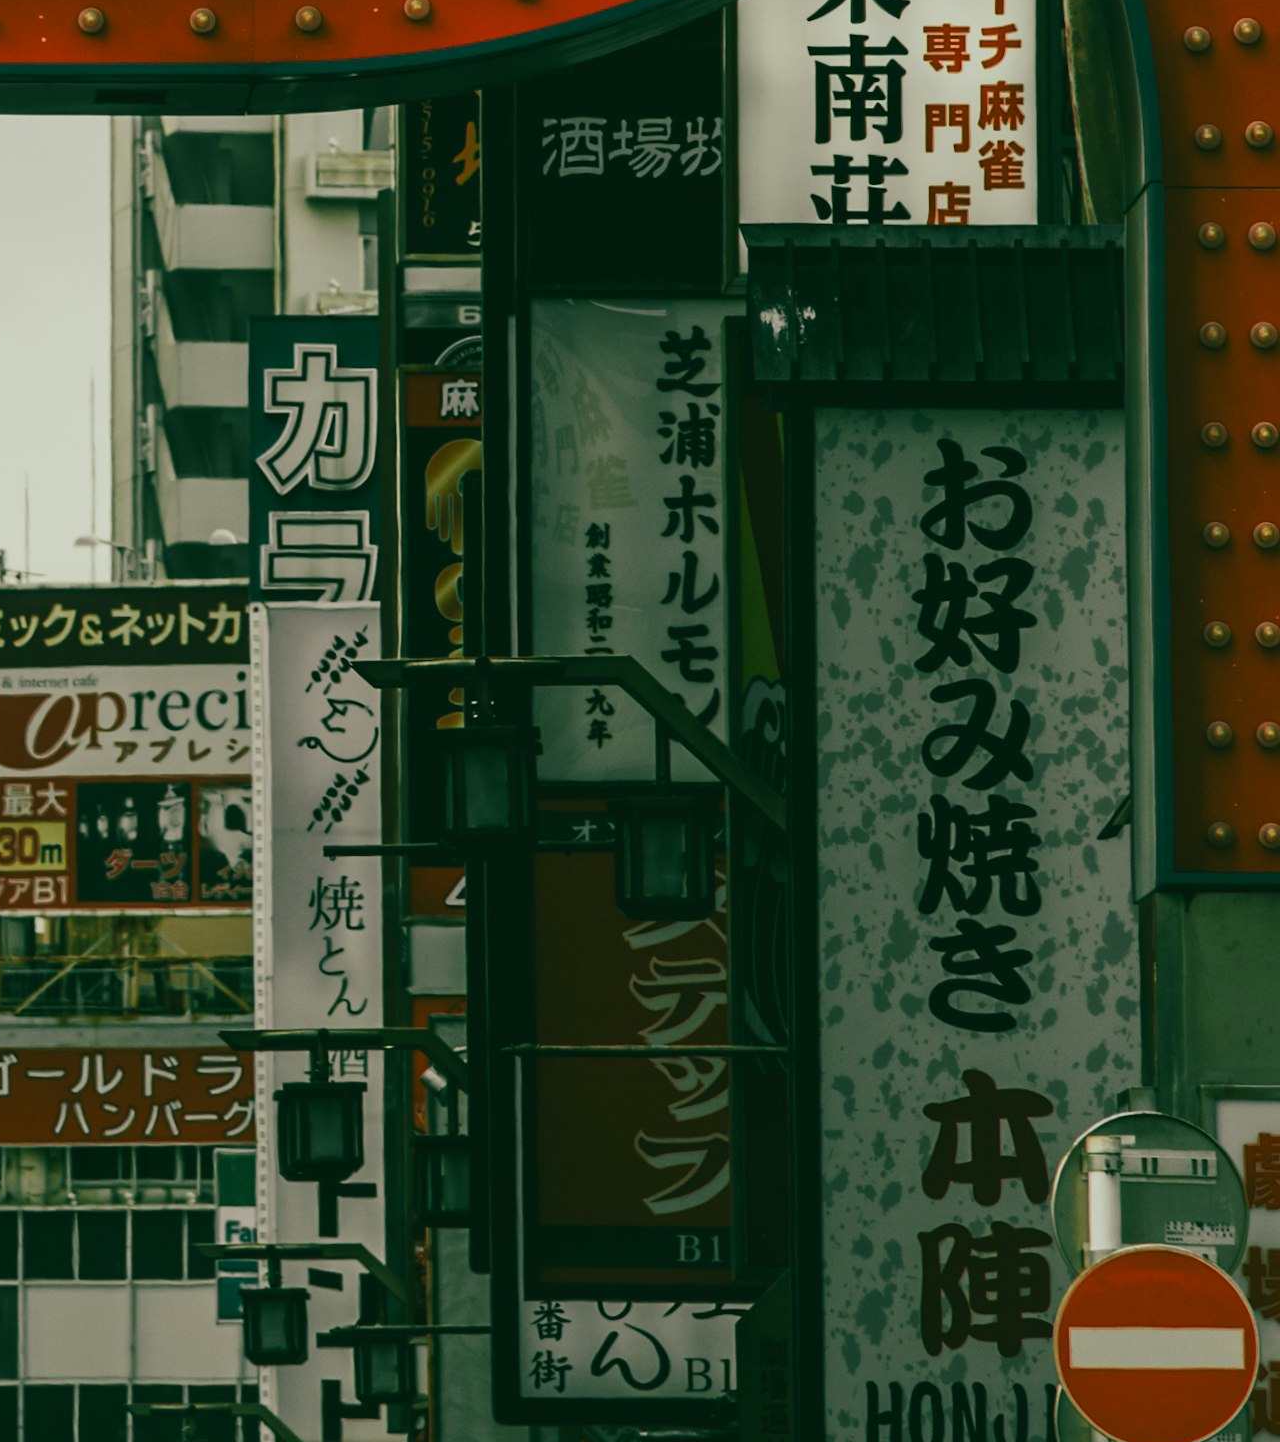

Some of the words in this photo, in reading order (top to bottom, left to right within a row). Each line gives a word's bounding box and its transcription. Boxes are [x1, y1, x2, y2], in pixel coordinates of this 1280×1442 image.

[924, 26, 971, 226] 専門店
[584, 522, 616, 748] 創業昭和二九年
[913, 438, 1043, 1033] お好み焼き
[677, 1233, 725, 1263] B1
[915, 1069, 1054, 1357] 本陣
